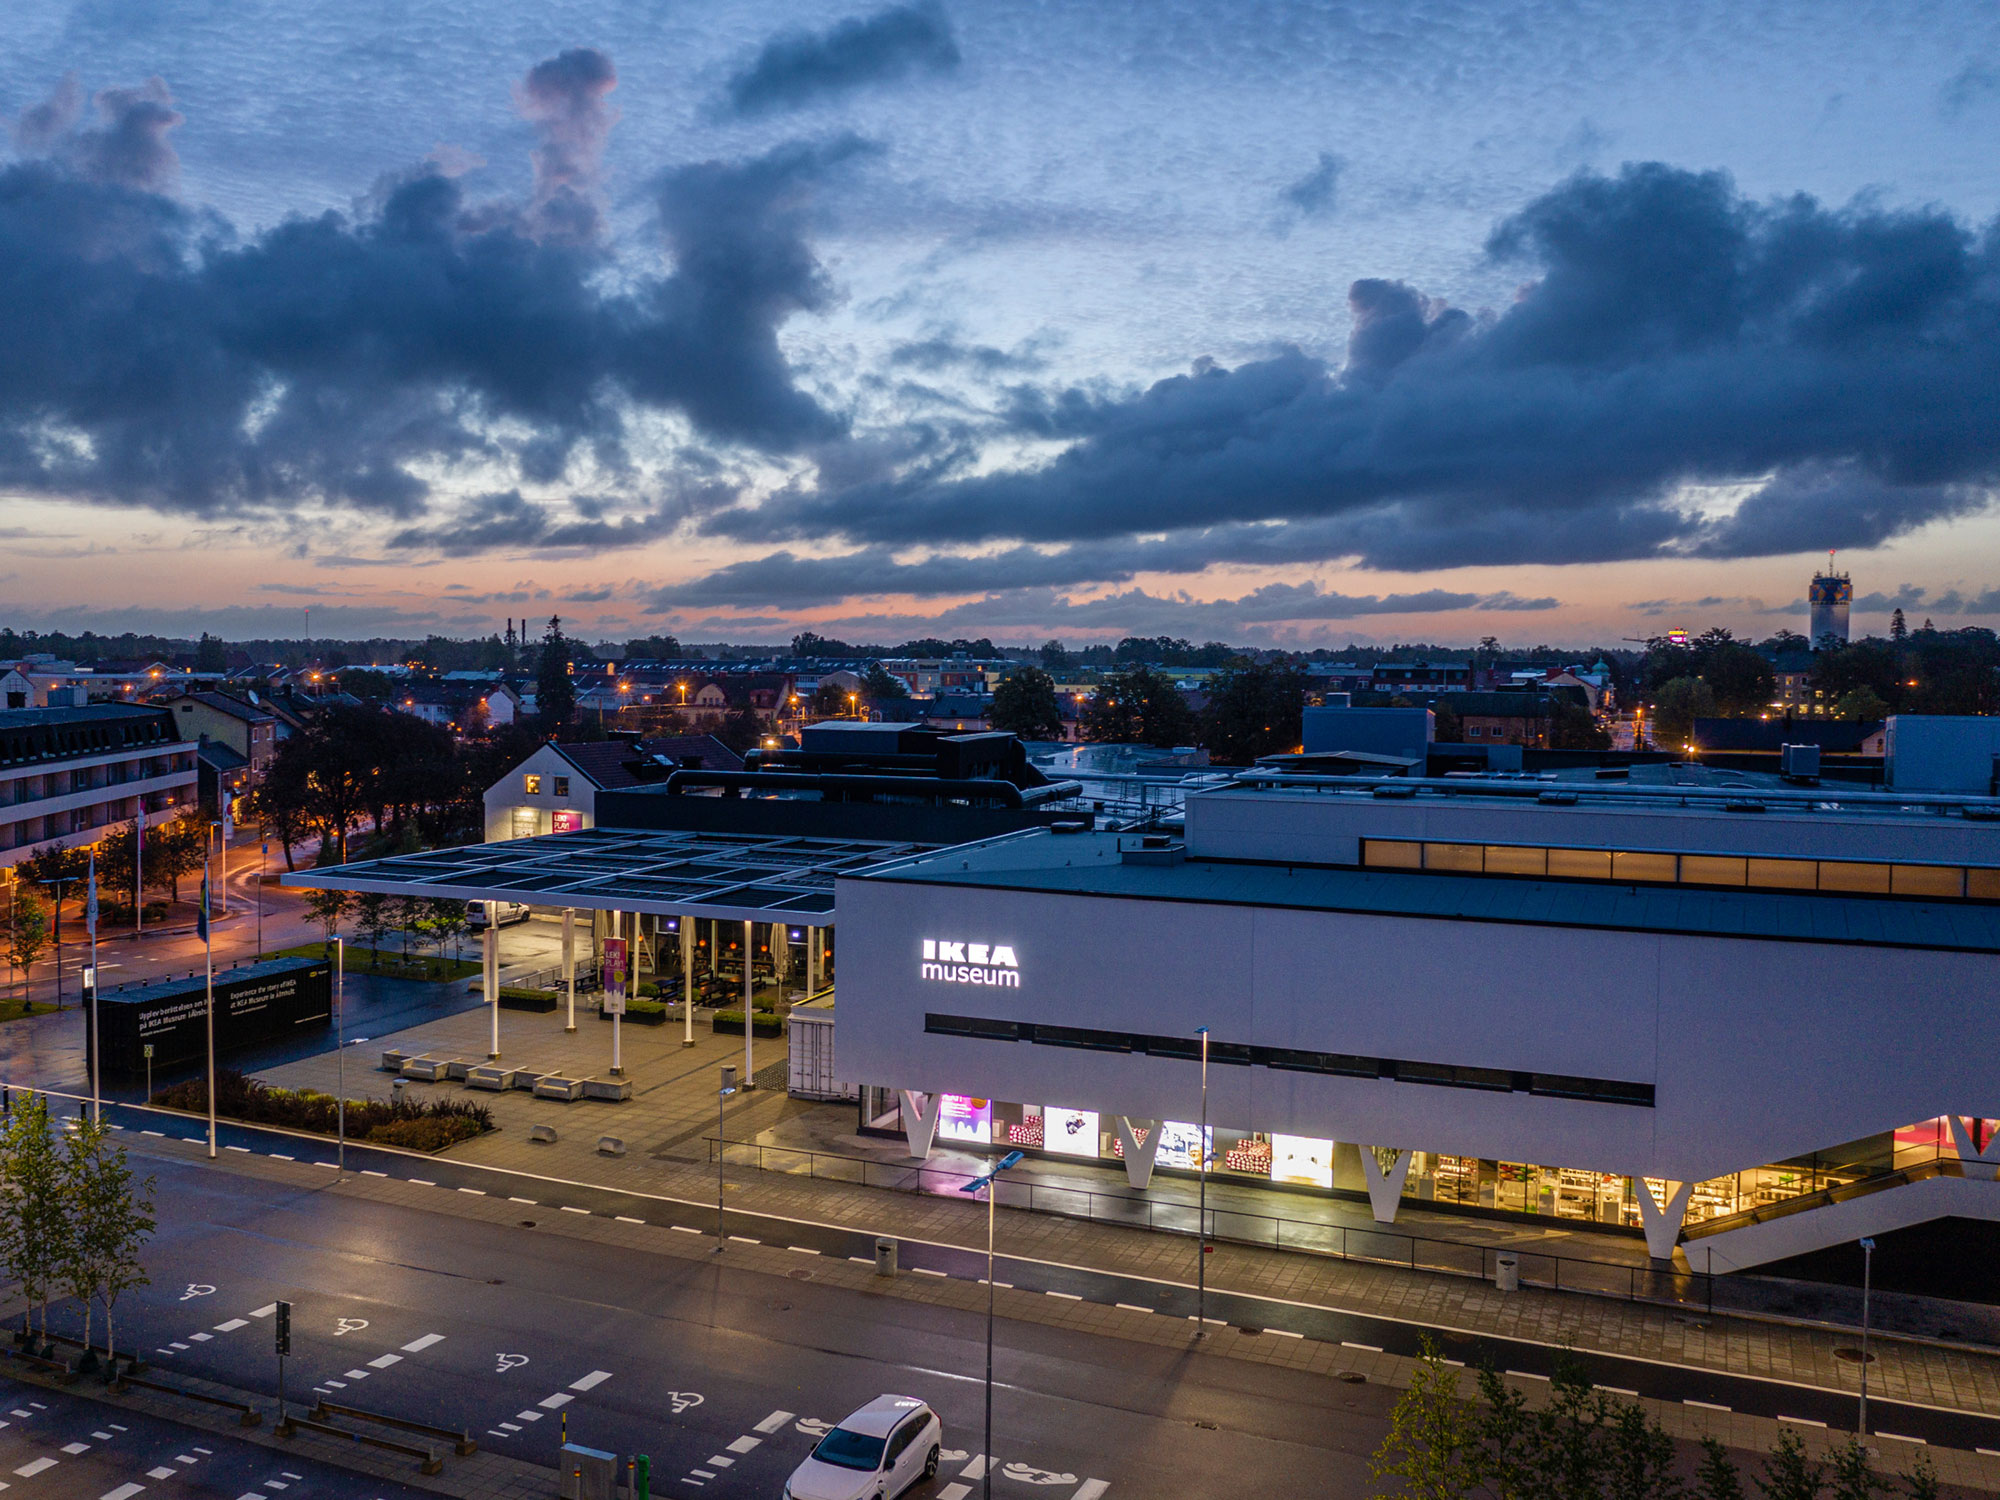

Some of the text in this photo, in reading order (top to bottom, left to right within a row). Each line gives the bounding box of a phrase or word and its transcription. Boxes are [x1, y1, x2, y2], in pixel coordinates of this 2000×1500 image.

[554, 821, 570, 830] PLAY!
[605, 951, 620, 959] LEK!
[923, 939, 1019, 967] IKEA
[605, 958, 624, 968] PLAY!
[922, 962, 1020, 987] museum
